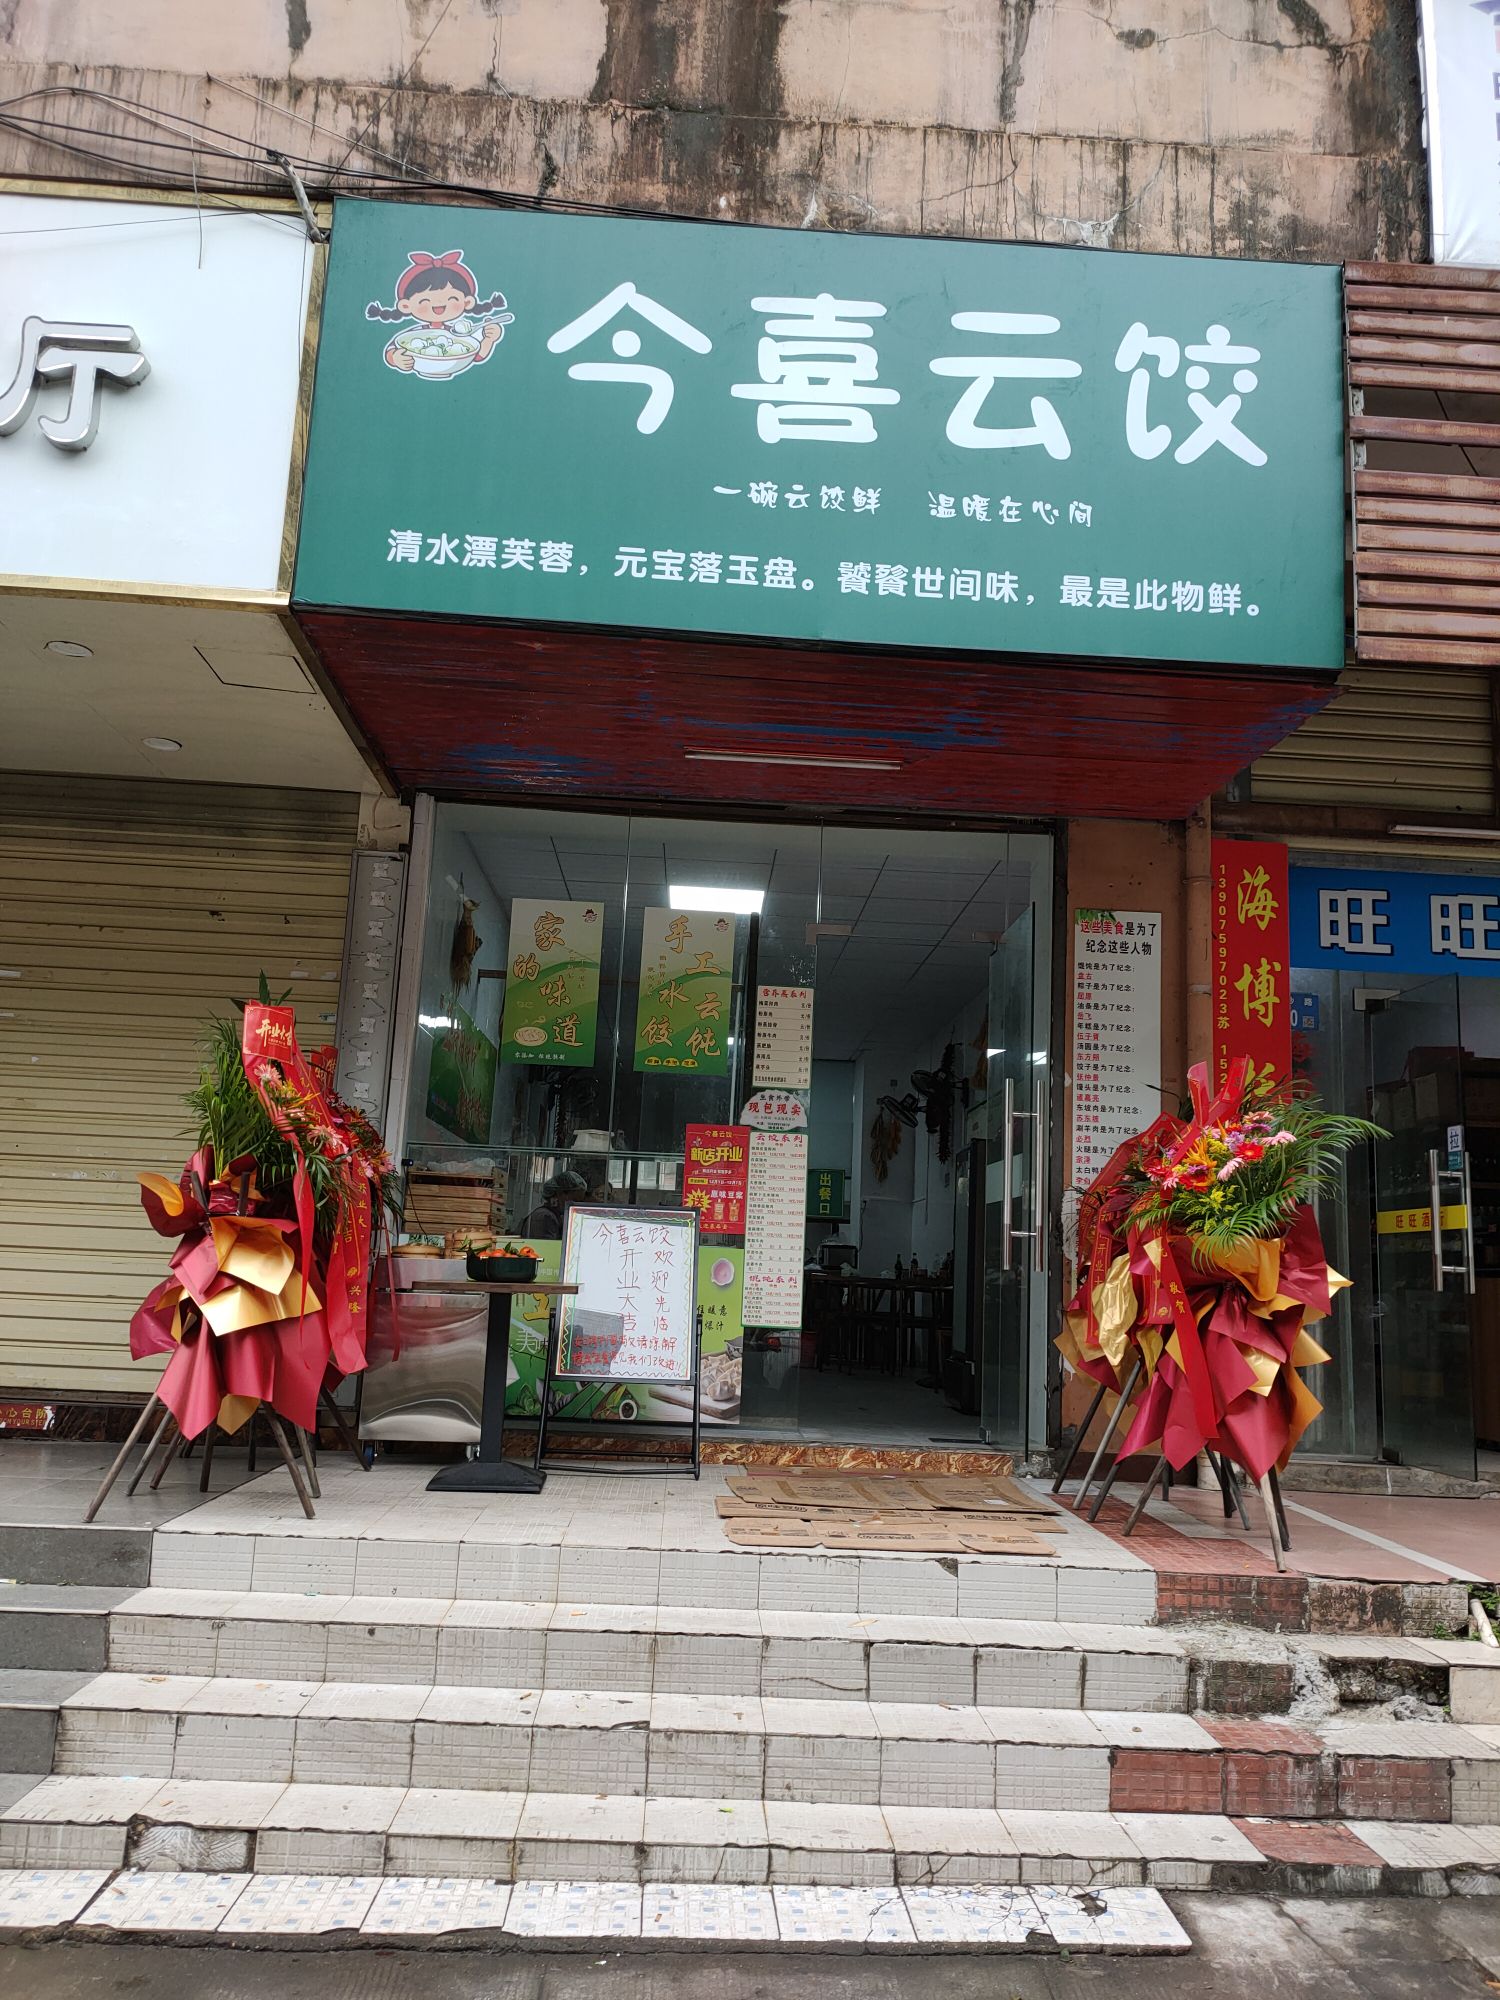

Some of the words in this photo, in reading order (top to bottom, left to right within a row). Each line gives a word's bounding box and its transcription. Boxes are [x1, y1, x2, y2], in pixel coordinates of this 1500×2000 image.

[547, 282, 1268, 467] 今喜云饺
[713, 481, 882, 515] 一碗云饺鲜
[928, 490, 1093, 528] 温暖在心间
[1080, 919, 1158, 937] 这些美食是为了
[1318, 888, 1500, 960] 旺旺
[1086, 939, 1153, 956] 纪念这些人物
[513, 911, 585, 1048] 家的味道
[1219, 1041, 1231, 1091] 152
[748, 1102, 801, 1117] 现包现卖
[690, 1145, 744, 1167] 新店开业
[689, 1194, 708, 1209] 送
[710, 1189, 744, 1200] 原味豆浆
[592, 1222, 677, 1247] 今喜云饺
[616, 1248, 643, 1331] 开业大吉
[651, 1249, 675, 1334] 欢迎光临
[0, 1408, 46, 1419] 心台阶
